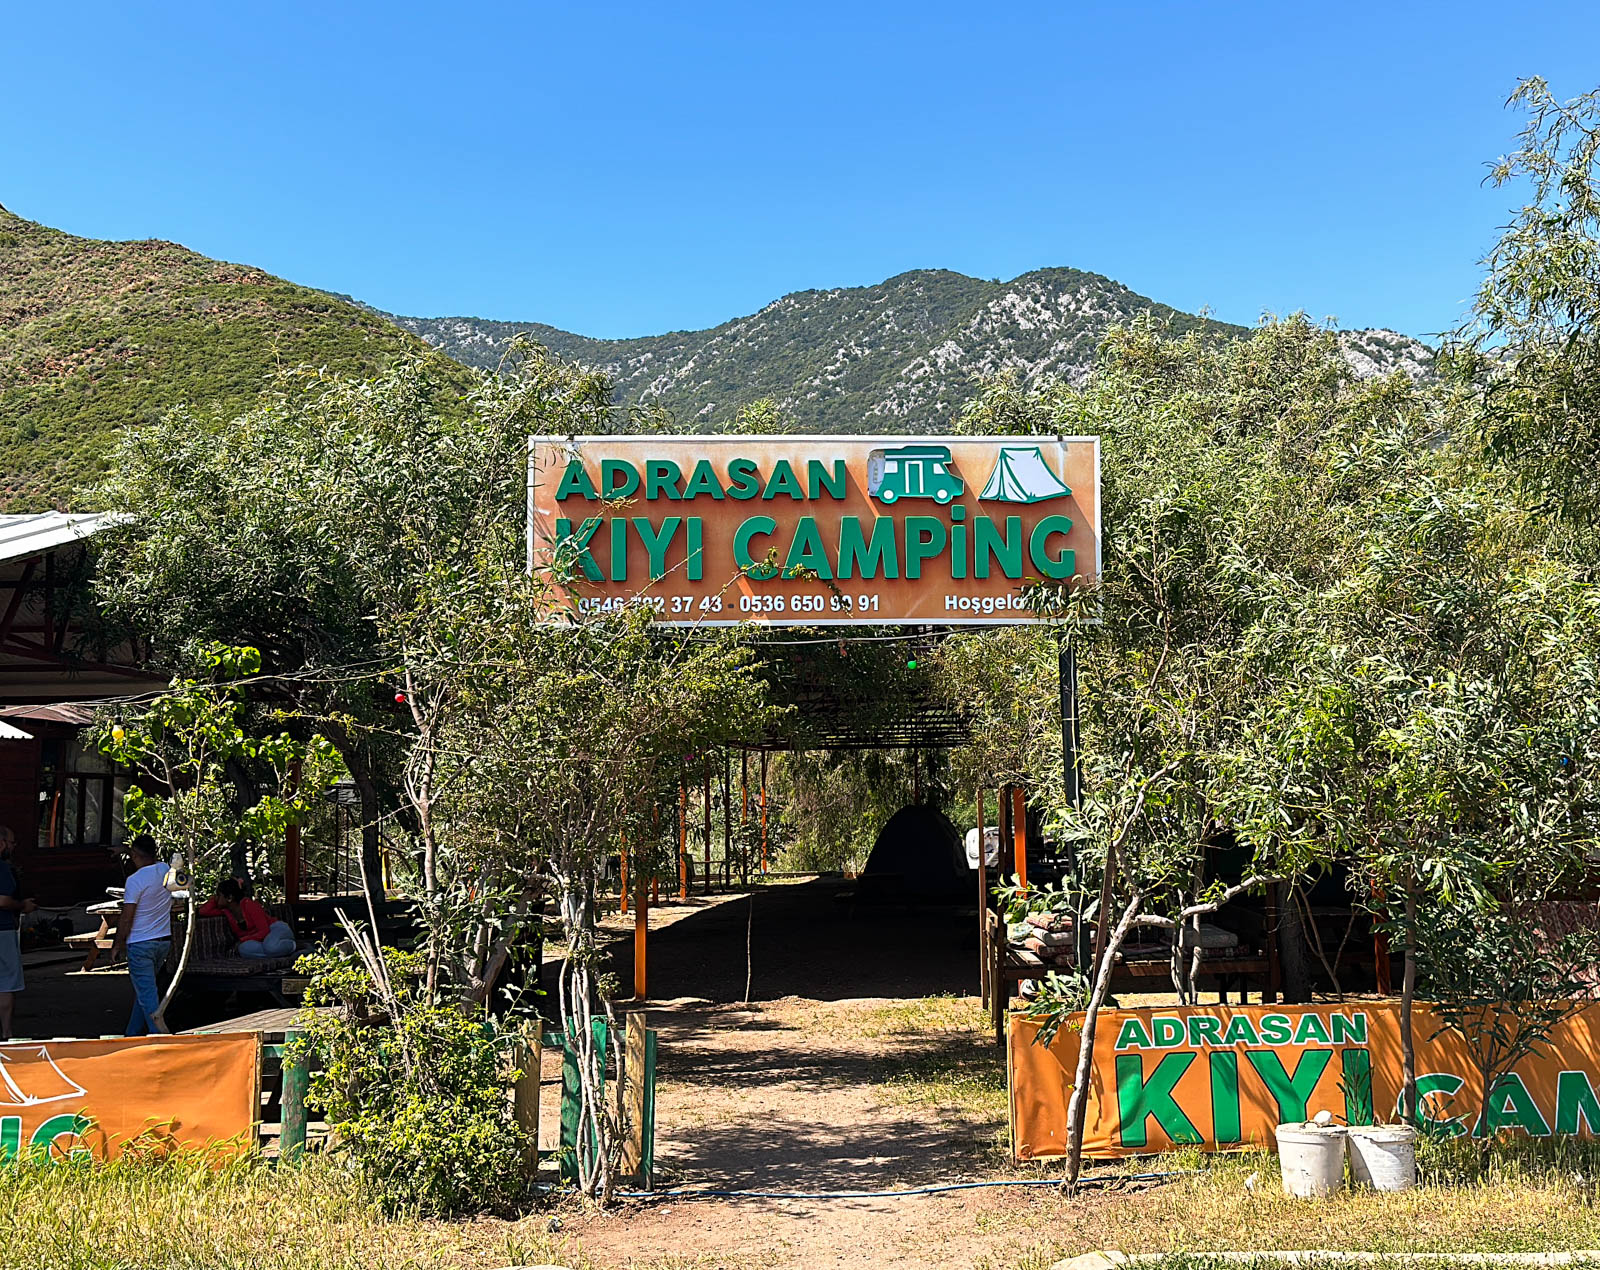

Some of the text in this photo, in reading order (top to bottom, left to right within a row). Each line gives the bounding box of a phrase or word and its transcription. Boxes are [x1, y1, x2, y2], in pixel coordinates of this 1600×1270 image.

[555, 458, 846, 501] ADRASAN
[555, 516, 703, 582] KIYI
[671, 596, 694, 613] 37
[699, 596, 723, 613] 43
[739, 595, 785, 612] 0536
[790, 594, 825, 612] 650
[858, 594, 879, 611] 91
[1115, 1012, 1368, 1050] ADRASAN
[1114, 1048, 1375, 1148] KIYI
